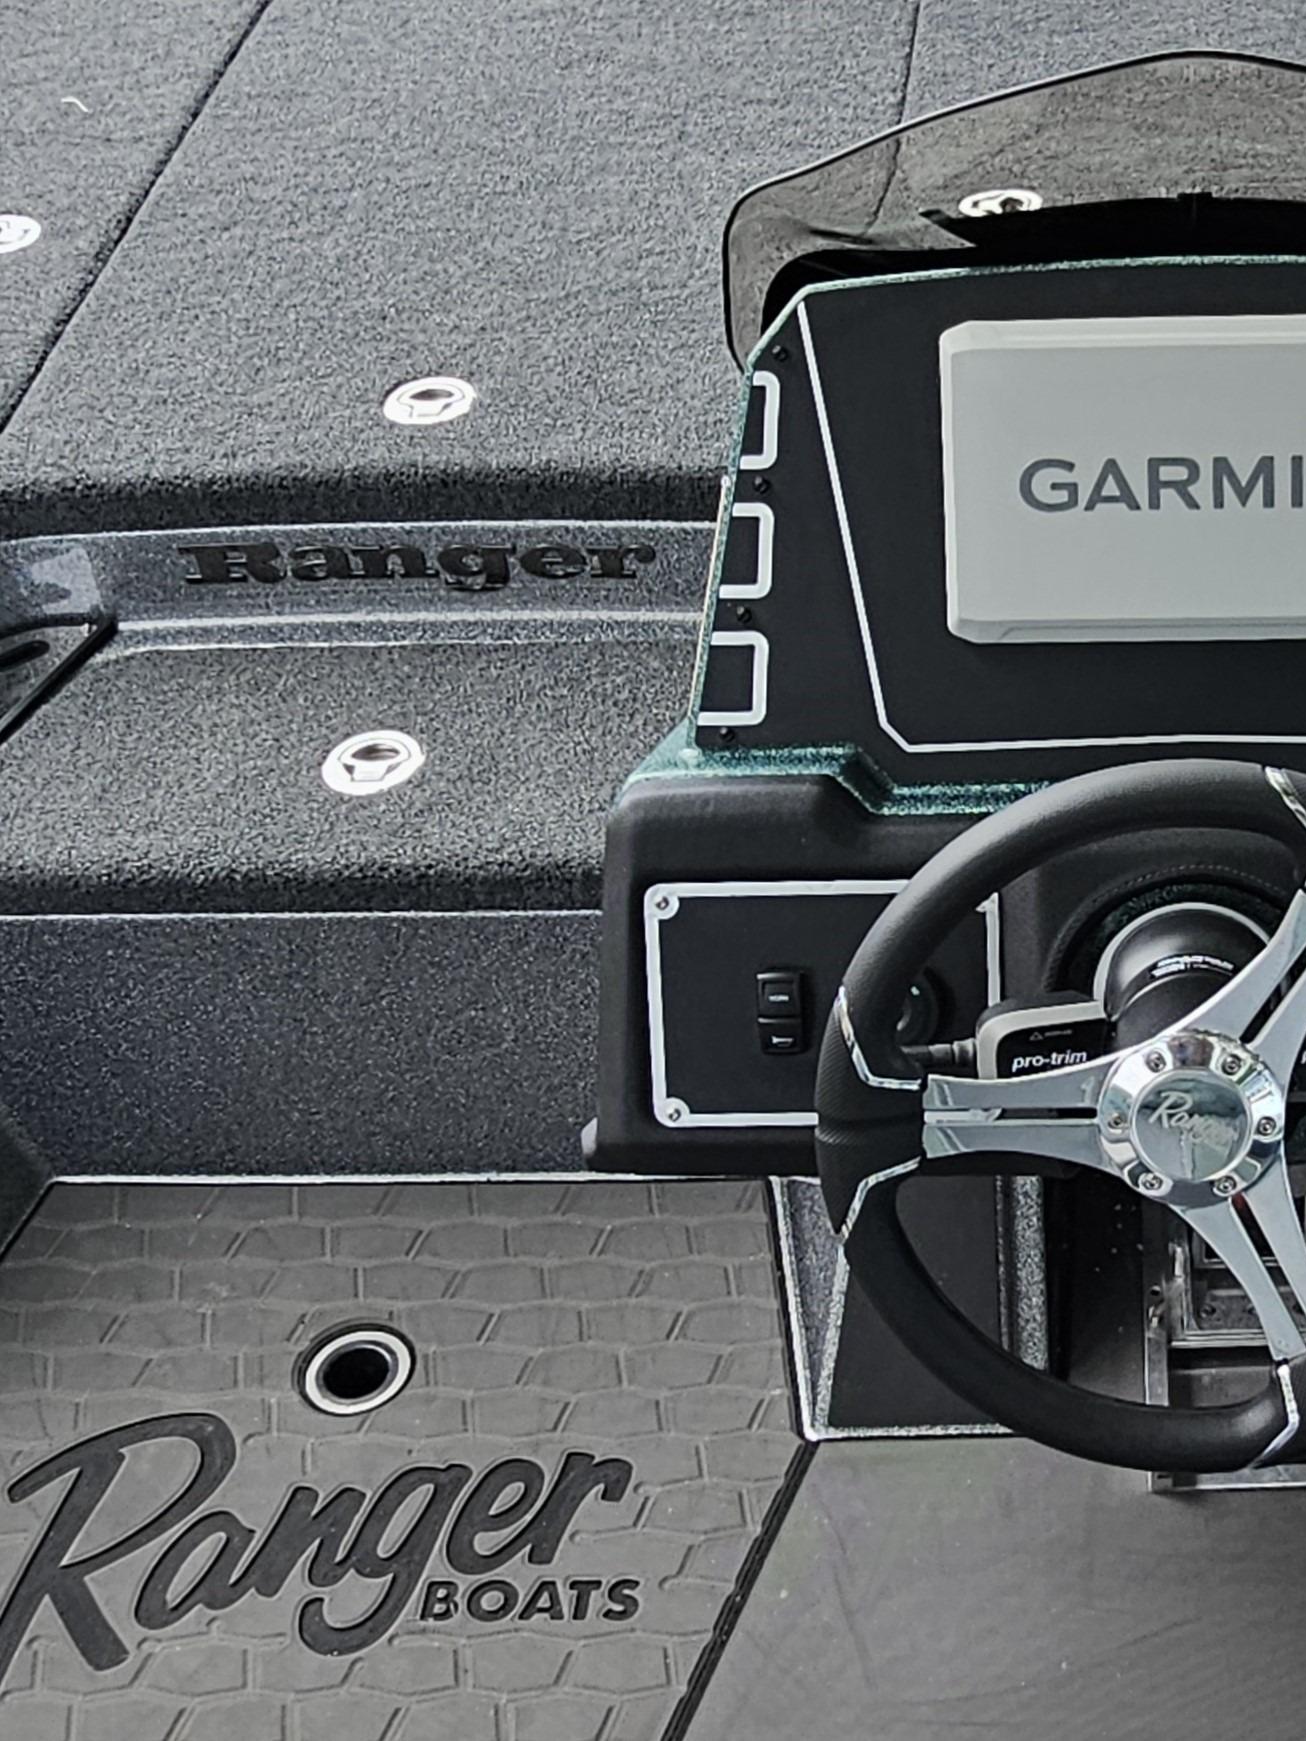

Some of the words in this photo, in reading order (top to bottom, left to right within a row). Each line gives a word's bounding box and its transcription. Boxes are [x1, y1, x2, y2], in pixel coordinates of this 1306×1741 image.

[176, 541, 657, 592] Ranger
[1011, 1049, 1088, 1073] pro-trim
[0, 1412, 635, 1687] Ranger
[418, 1577, 641, 1622] BOATS
